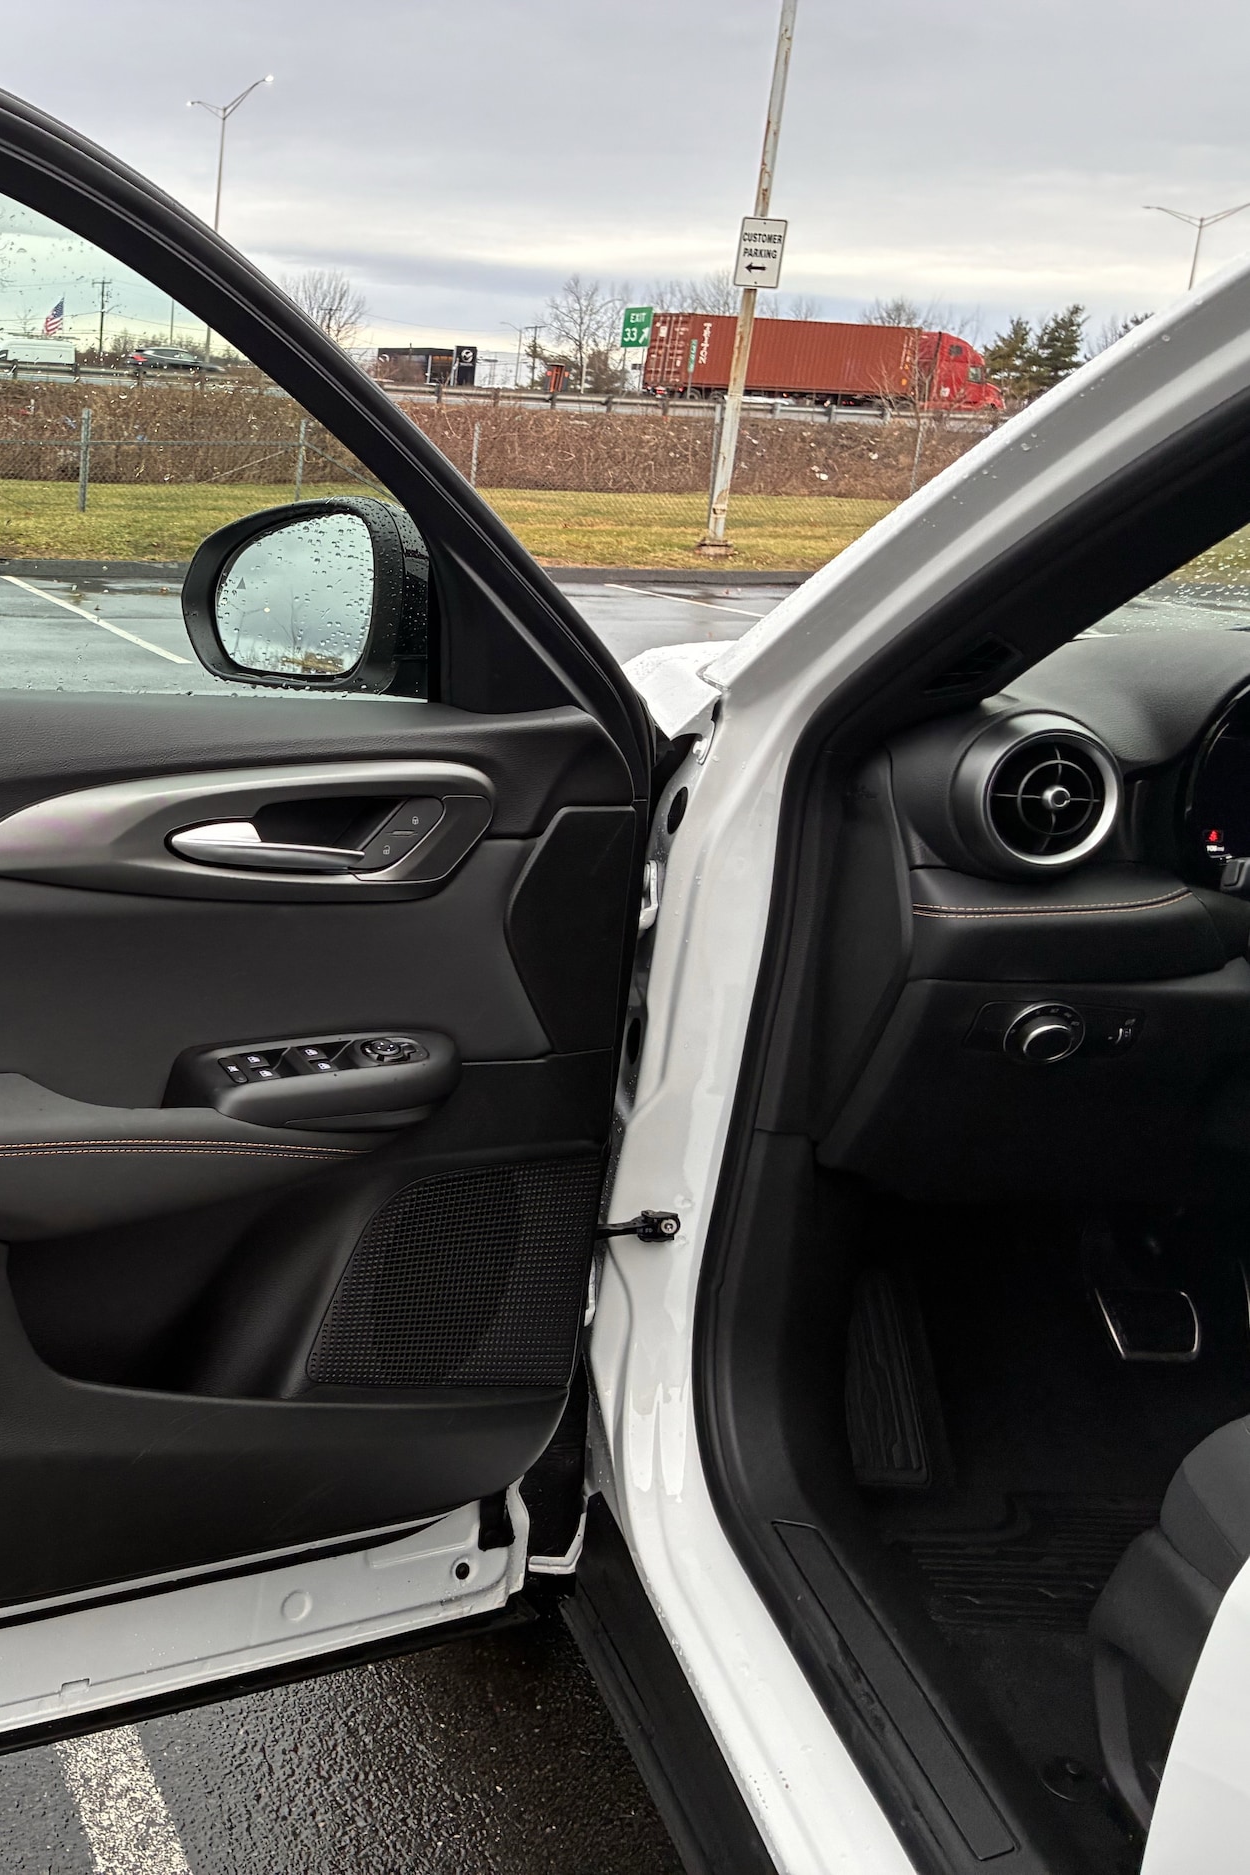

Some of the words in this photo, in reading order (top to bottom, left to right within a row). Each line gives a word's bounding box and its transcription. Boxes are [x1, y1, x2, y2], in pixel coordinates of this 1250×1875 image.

[742, 232, 782, 244] CUSTOMER
[743, 247, 777, 259] PARKING
[629, 312, 647, 324] EXIT
[623, 327, 638, 342] 33
